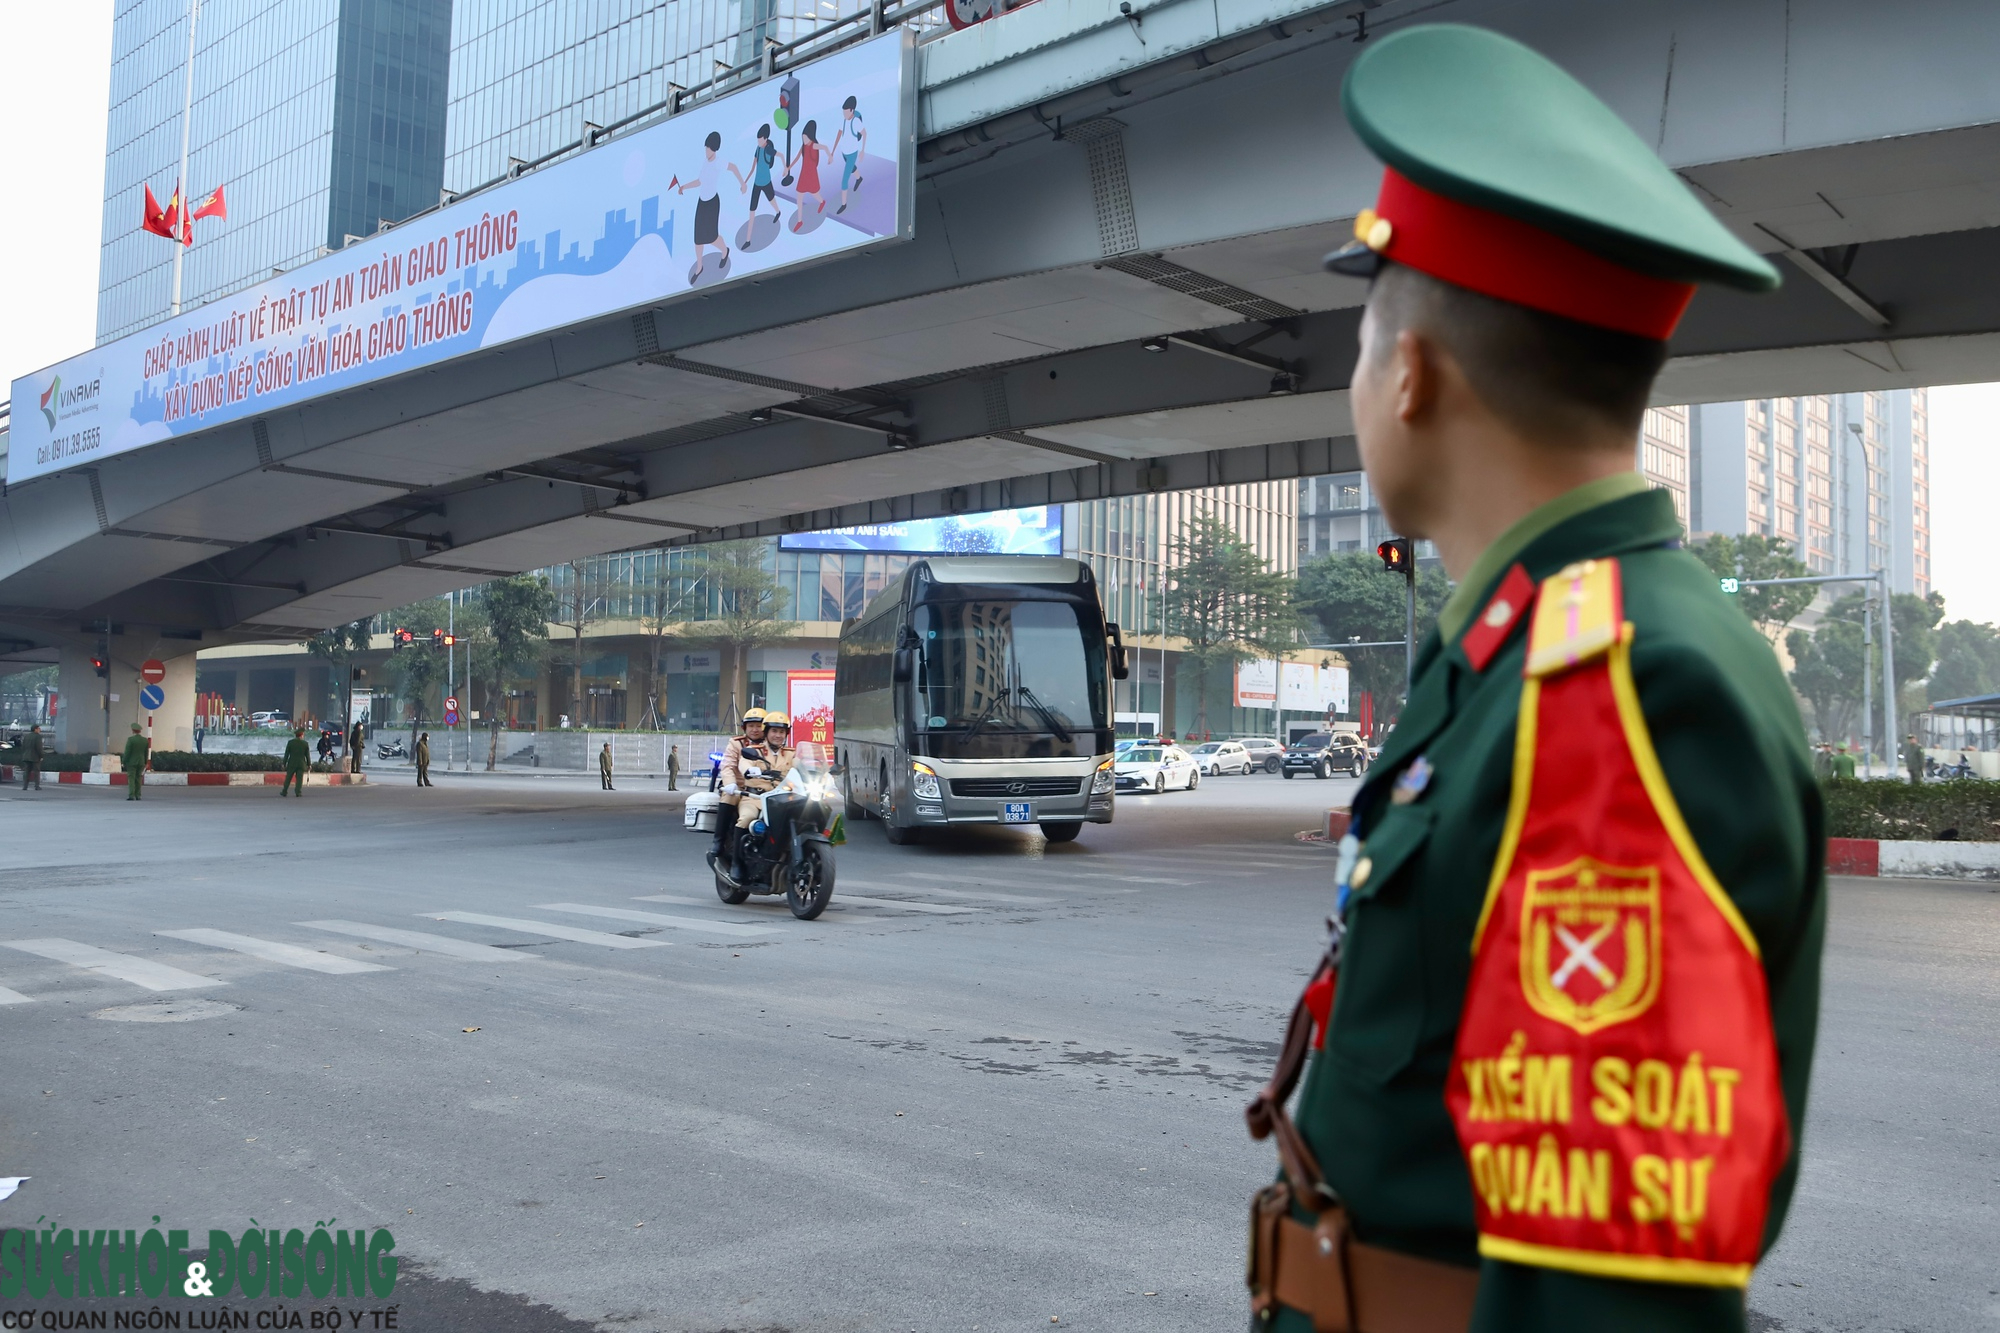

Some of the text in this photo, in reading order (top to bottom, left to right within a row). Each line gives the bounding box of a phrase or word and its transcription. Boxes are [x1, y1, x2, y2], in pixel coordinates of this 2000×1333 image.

[144, 209, 518, 380] CHẤP HÀNH LUẬT VỀ TRẬT TỰ AN TOÀN GIAO THÔNG
[164, 291, 472, 422] XÂY DỰNG NẾP SỐNG VĂN HÓA GIAO THÔNG
[60, 379, 100, 408] VINAMA
[37, 426, 101, 465] Call: 0911.39.5555
[812, 731, 826, 742] XIV
[1010, 804, 1025, 812] 80A
[1462, 1030, 1741, 1137] KIỂM SOÁT
[1470, 1132, 1715, 1241] QUÂN SỰ
